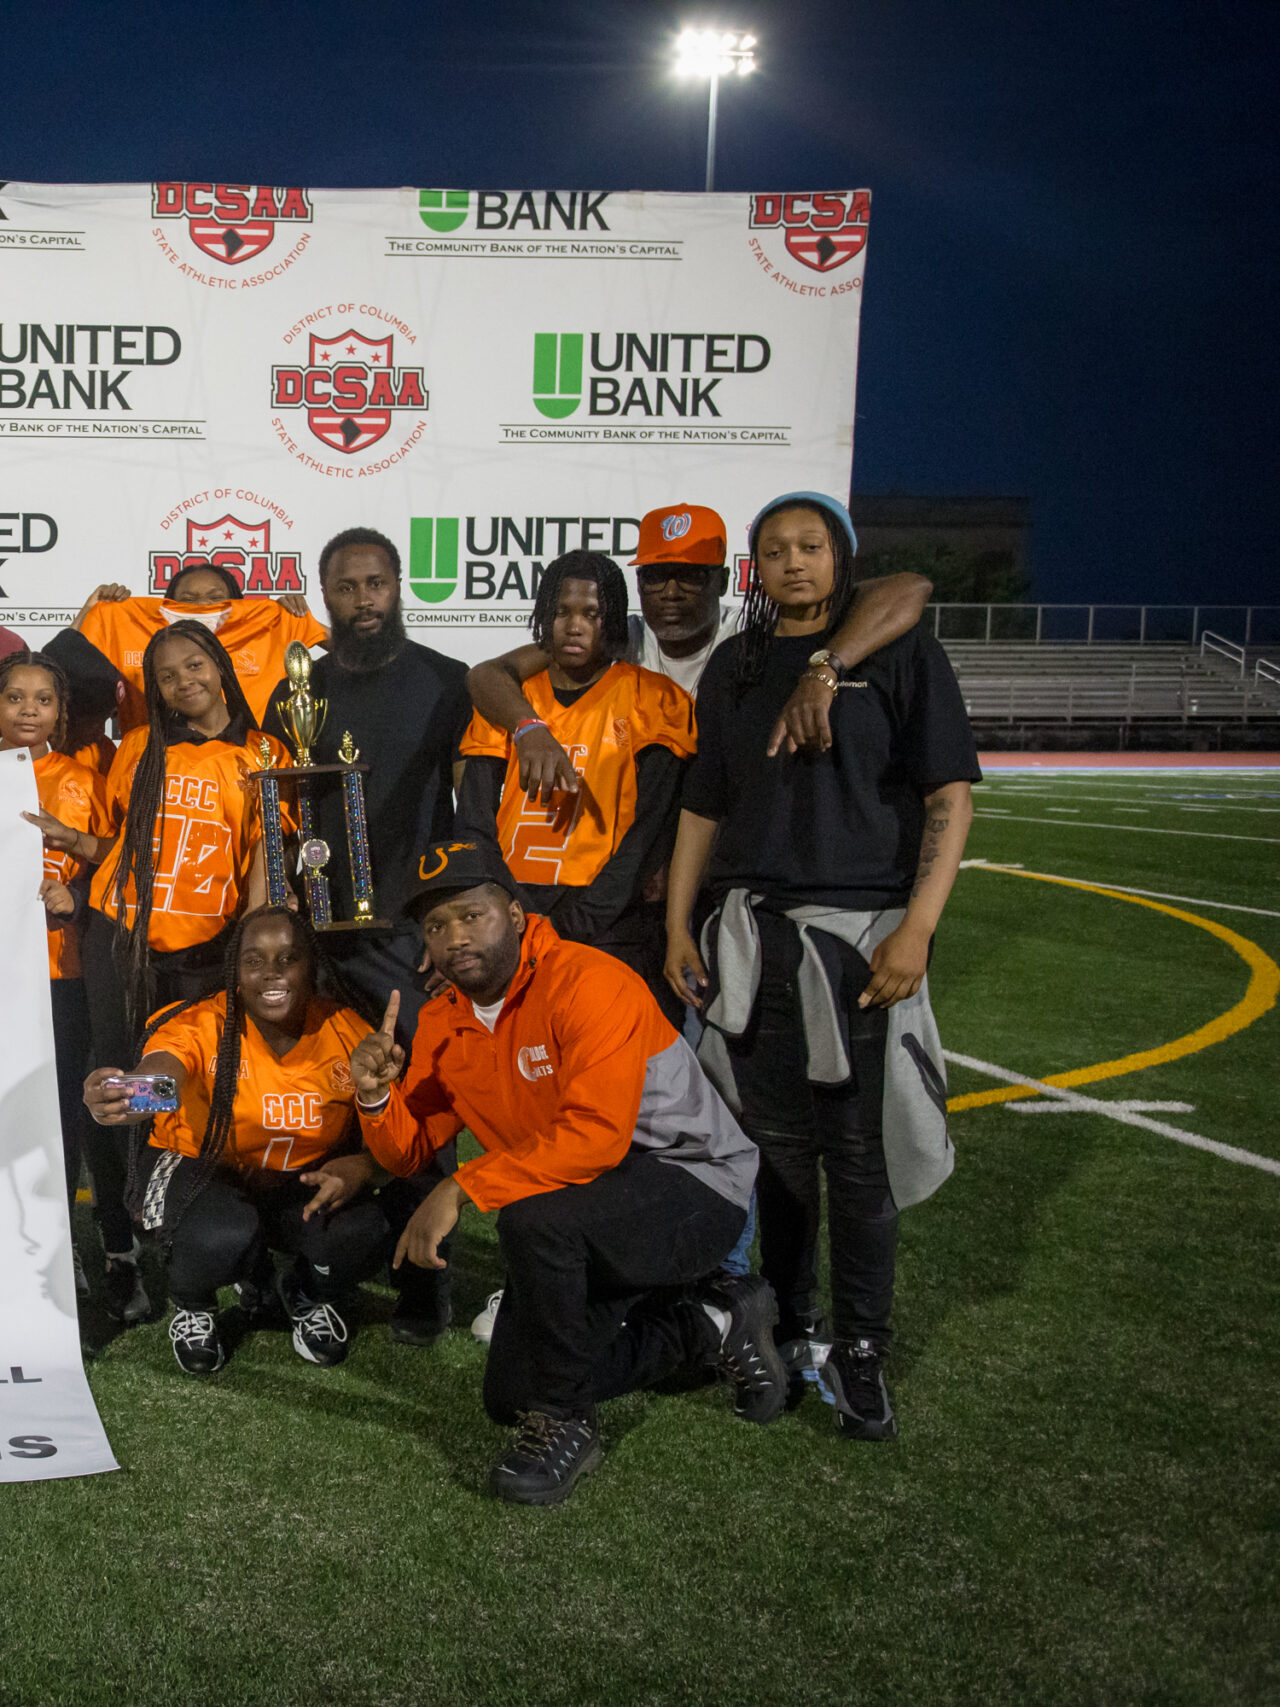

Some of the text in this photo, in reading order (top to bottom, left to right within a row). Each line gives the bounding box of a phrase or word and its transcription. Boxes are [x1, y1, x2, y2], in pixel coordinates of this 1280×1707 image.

[152, 182, 313, 225] DCSAA
[476, 191, 613, 231] BANK
[749, 191, 871, 232] DCSA
[152, 228, 312, 289] STATE ATHLETIC ASSOCIATION
[749, 238, 774, 273] STATE
[771, 272, 826, 297] ATHLETIC
[283, 303, 417, 345] DISTRICT OF COLUMBIA
[590, 332, 771, 373] UNITED
[270, 361, 429, 414] DCSAA
[588, 377, 723, 418] BANK
[271, 417, 427, 478] STATE ATHLETIC ASSOCIATION
[159, 488, 295, 531] DISTRICT OF COLUMBIA
[262, 1093, 323, 1129] CCC
